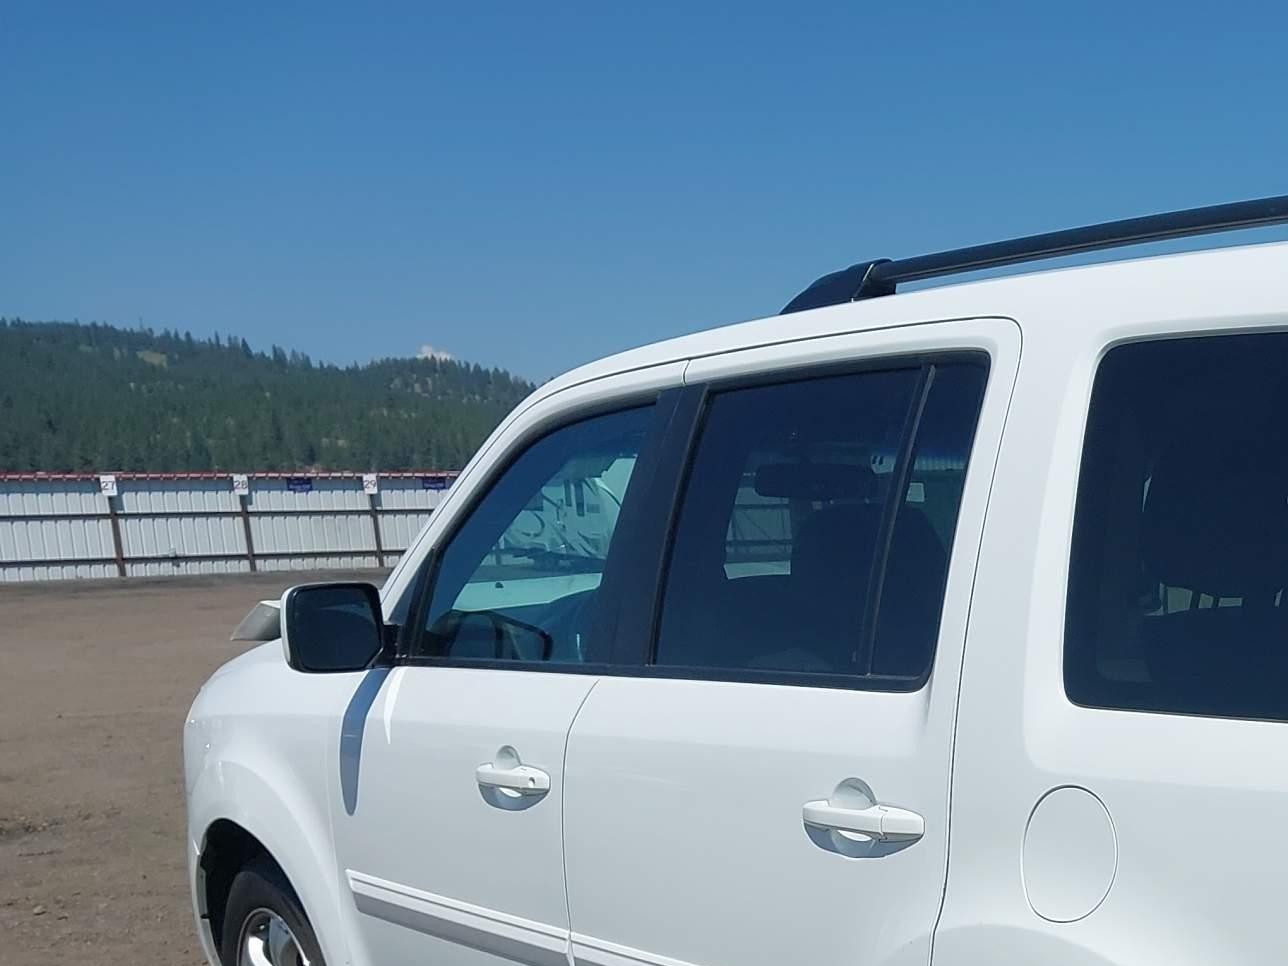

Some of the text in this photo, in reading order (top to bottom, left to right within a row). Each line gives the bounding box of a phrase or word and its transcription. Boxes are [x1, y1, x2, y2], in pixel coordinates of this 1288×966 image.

[102, 480, 116, 491] 27
[234, 479, 249, 490] 28
[364, 479, 377, 490] 29
